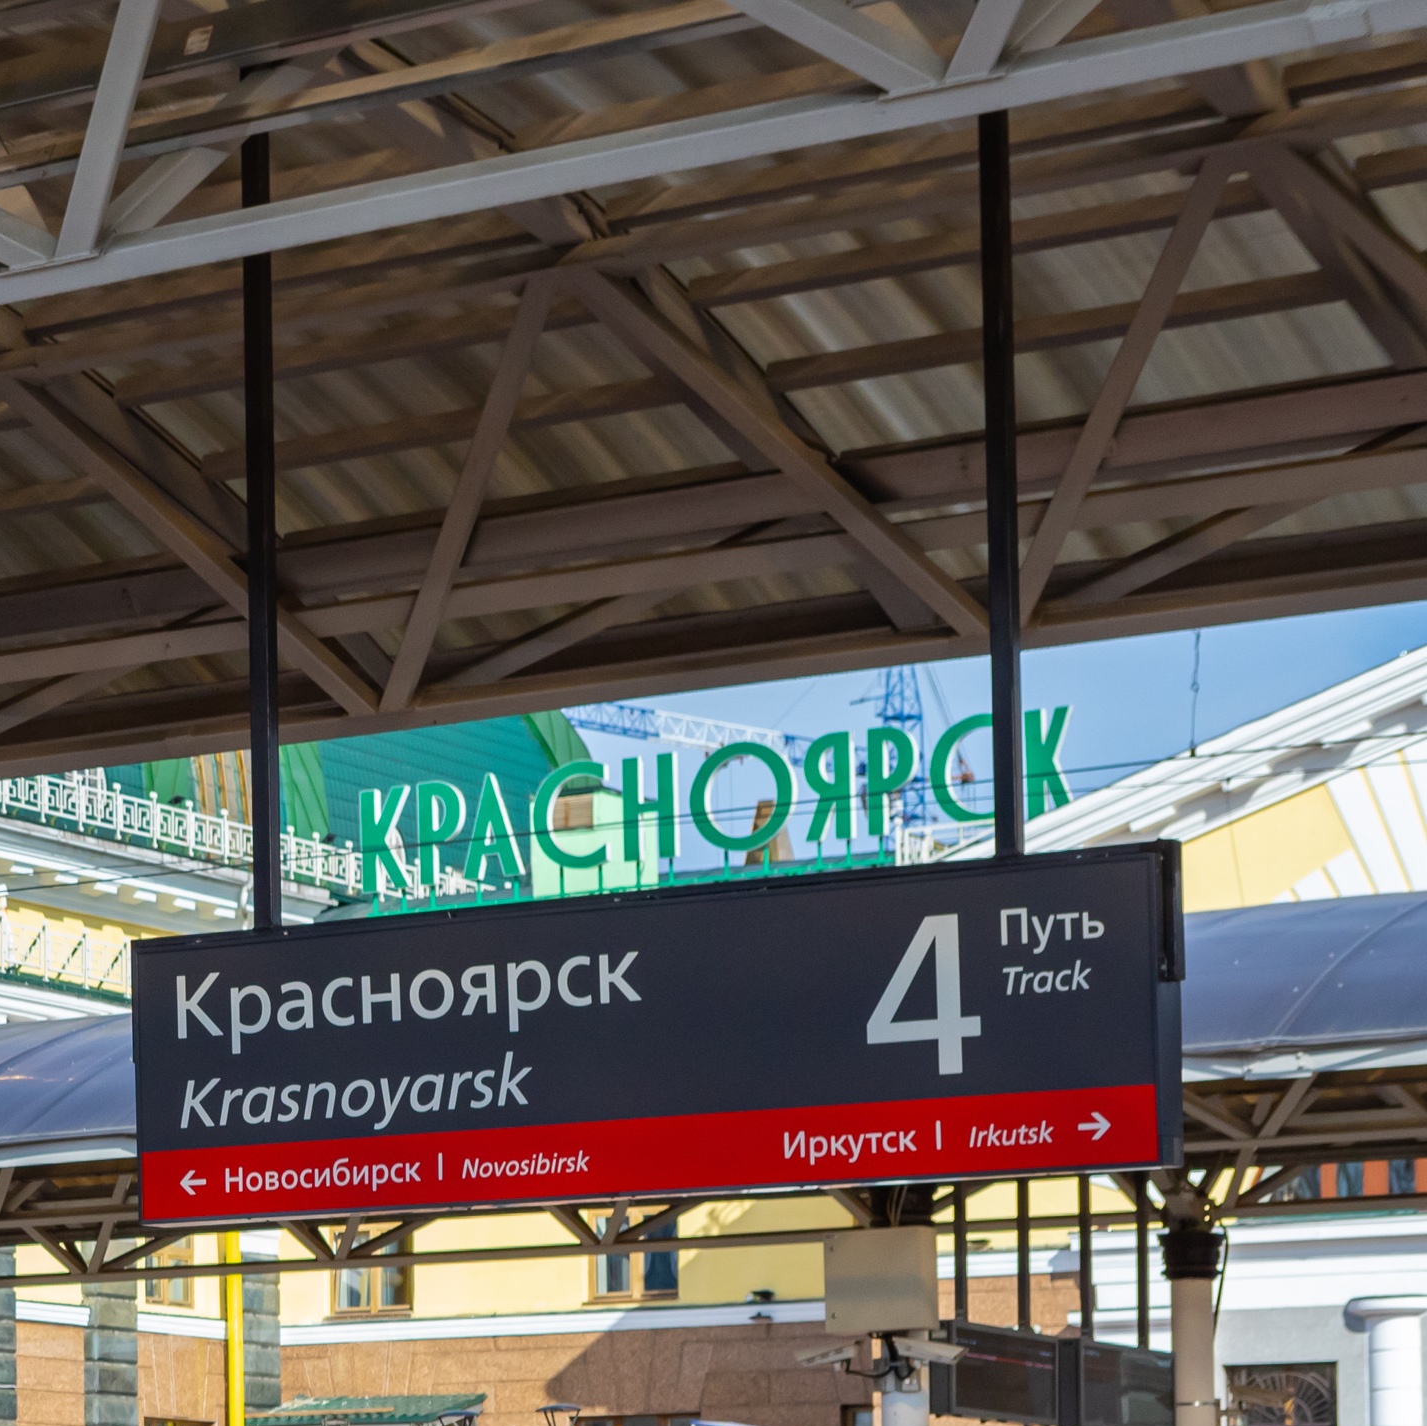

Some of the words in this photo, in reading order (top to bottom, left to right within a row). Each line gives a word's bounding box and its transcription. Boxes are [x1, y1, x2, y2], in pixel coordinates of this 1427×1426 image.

[358, 704, 1073, 895] КРАСНОЯРСК
[867, 914, 980, 1075] 4
[1000, 907, 1105, 951] Путь
[1002, 959, 1092, 995] Track
[176, 951, 642, 1054] Красноярск
[181, 1051, 532, 1130] Krasnoyarsk
[783, 1126, 917, 1165] Иркутск
[969, 1118, 1054, 1148] Irkutsk
[225, 1156, 421, 1193] Новосибирск
[462, 1149, 590, 1179] Novosibirsk
